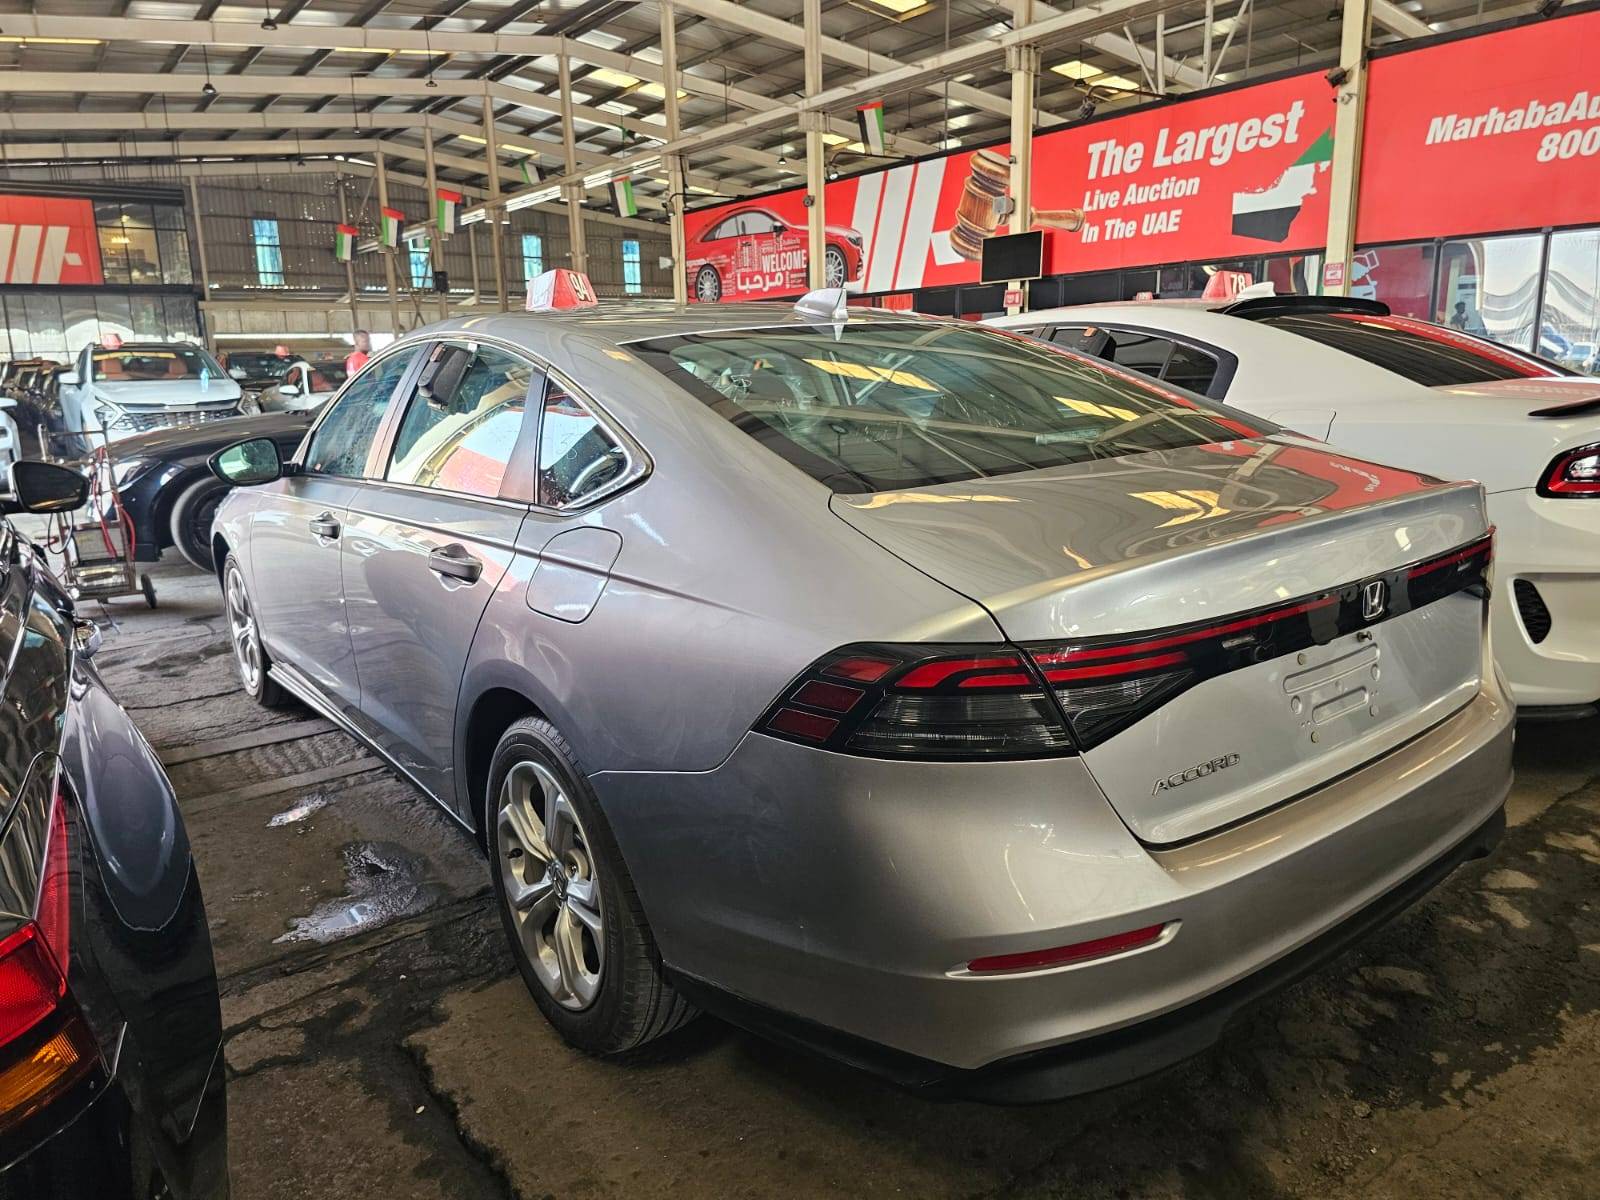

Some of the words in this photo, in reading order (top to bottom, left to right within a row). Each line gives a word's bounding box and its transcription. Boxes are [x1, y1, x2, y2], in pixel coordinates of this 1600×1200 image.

[1087, 139, 1144, 180] The
[1152, 100, 1305, 167] Largest
[1536, 126, 1600, 162] 800
[1083, 190, 1120, 212] Live
[1122, 176, 1200, 206] Auction
[1081, 222, 1099, 243] In
[1104, 217, 1137, 240] The
[1141, 209, 1182, 235] UAE
[761, 249, 807, 273] WELCOME
[569, 272, 593, 302] 94
[737, 271, 783, 294] مرحبا
[1230, 273, 1246, 294] 78
[1152, 753, 1240, 798] ACCORD
